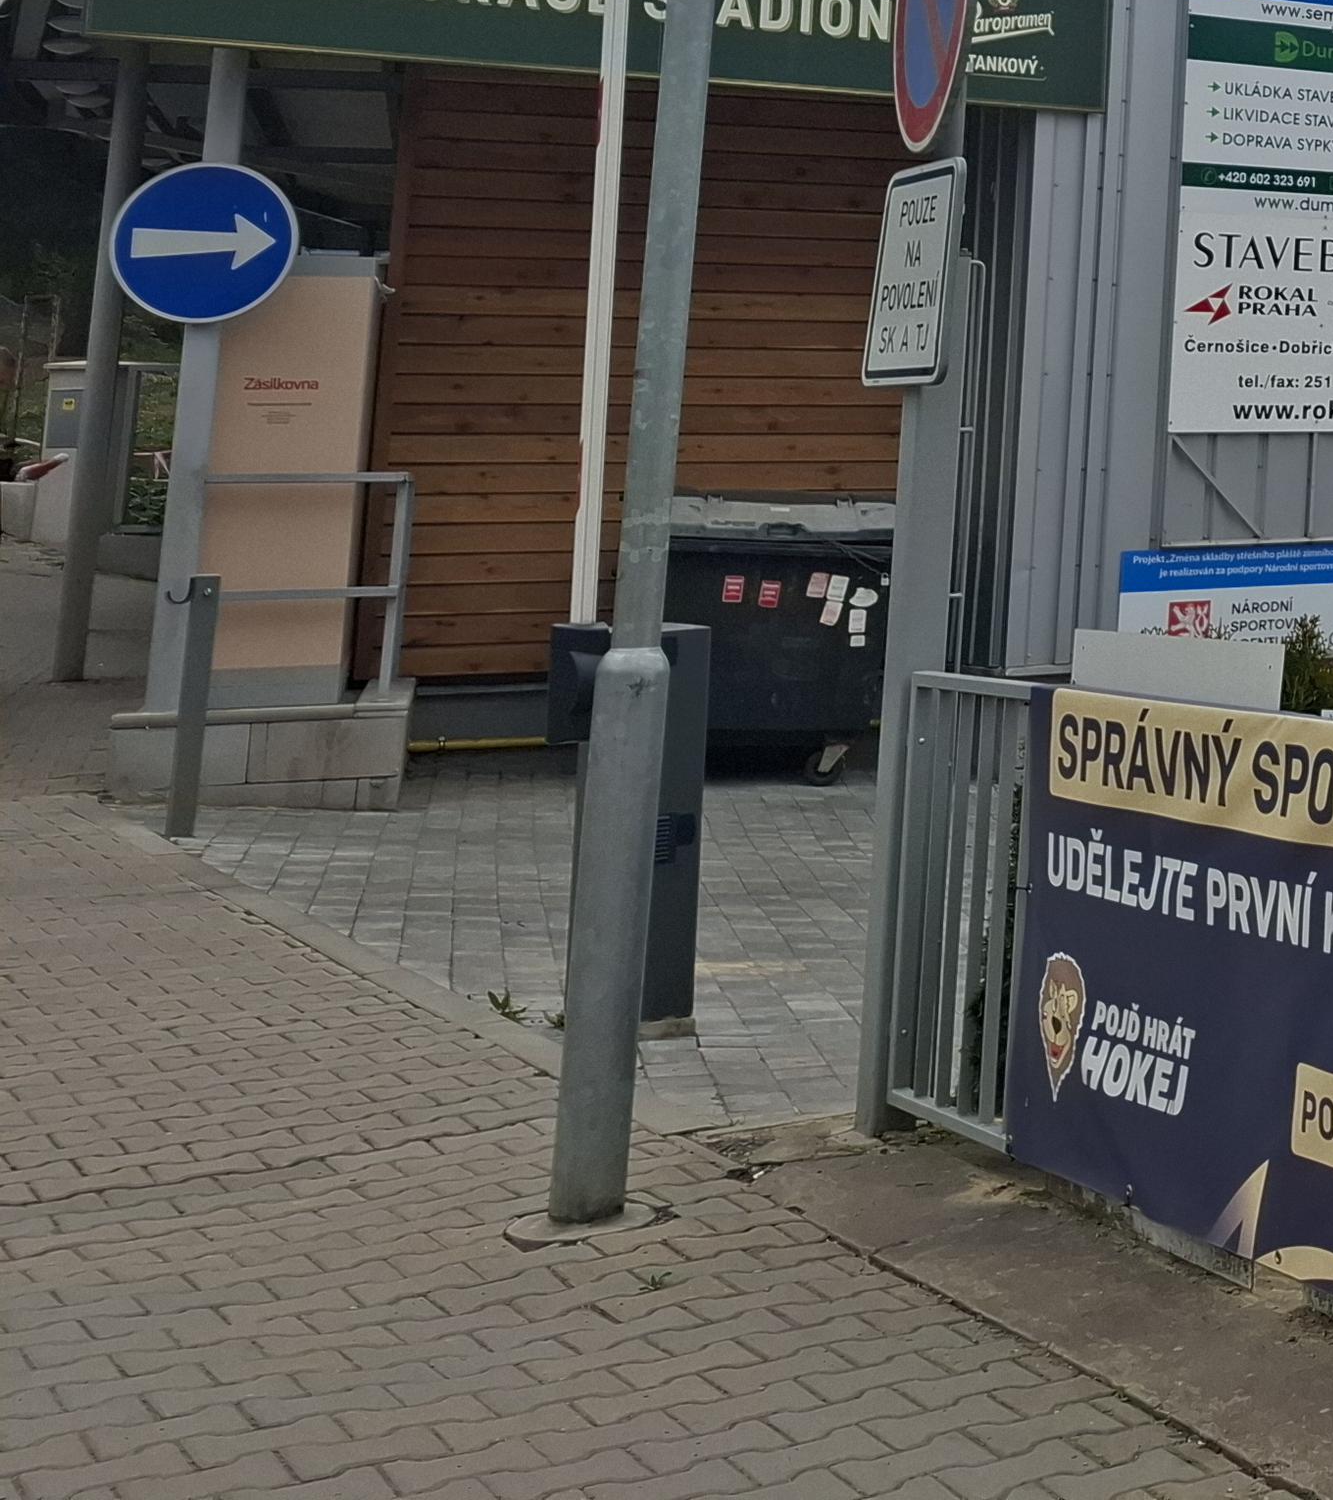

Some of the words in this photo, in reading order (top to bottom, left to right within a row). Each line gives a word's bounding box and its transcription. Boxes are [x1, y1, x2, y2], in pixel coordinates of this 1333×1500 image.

[974, 1, 1055, 36] aropramen
[1225, 81, 1293, 101] UKLÁDKA
[1223, 107, 1300, 126] LIKVIDACE
[1222, 133, 1293, 150] DOPRAVA
[1218, 172, 1246, 184] +420
[1250, 173, 1270, 185] 602
[1273, 174, 1294, 186] 323
[1297, 176, 1316, 188] 691
[900, 195, 938, 227] POUZE
[904, 239, 921, 267] NA
[880, 272, 940, 312] POVOLENÍ
[1238, 285, 1318, 302] ROKAL
[1237, 302, 1317, 317] PRAHA
[879, 326, 896, 354] SK
[900, 324, 908, 353] A
[917, 323, 928, 352] TJ
[1184, 335, 1269, 354] Černošice
[244, 377, 319, 391] Zásilkovna
[1238, 374, 1299, 390] tel./fax:
[1304, 375, 1330, 388] 251
[1133, 555, 1165, 566] Projekt
[1202, 551, 1234, 562] skladby
[1159, 568, 1168, 579] je
[1169, 566, 1214, 577] realizován
[1215, 567, 1225, 575] za
[1227, 565, 1263, 576] podpory
[1265, 562, 1298, 572] Národní
[1231, 596, 1294, 615] NÁRODNÍ
[1230, 616, 1303, 633] SPORTOVN
[1056, 706, 1242, 808] SPRÁVNÝ
[1045, 828, 1196, 923] UDĚLEJTE
[1205, 870, 1320, 950] PRVNÍ
[1091, 1000, 1140, 1042] POJĎ
[1142, 1016, 1196, 1060] HRÁT
[1081, 1035, 1189, 1116] HOKEJ
